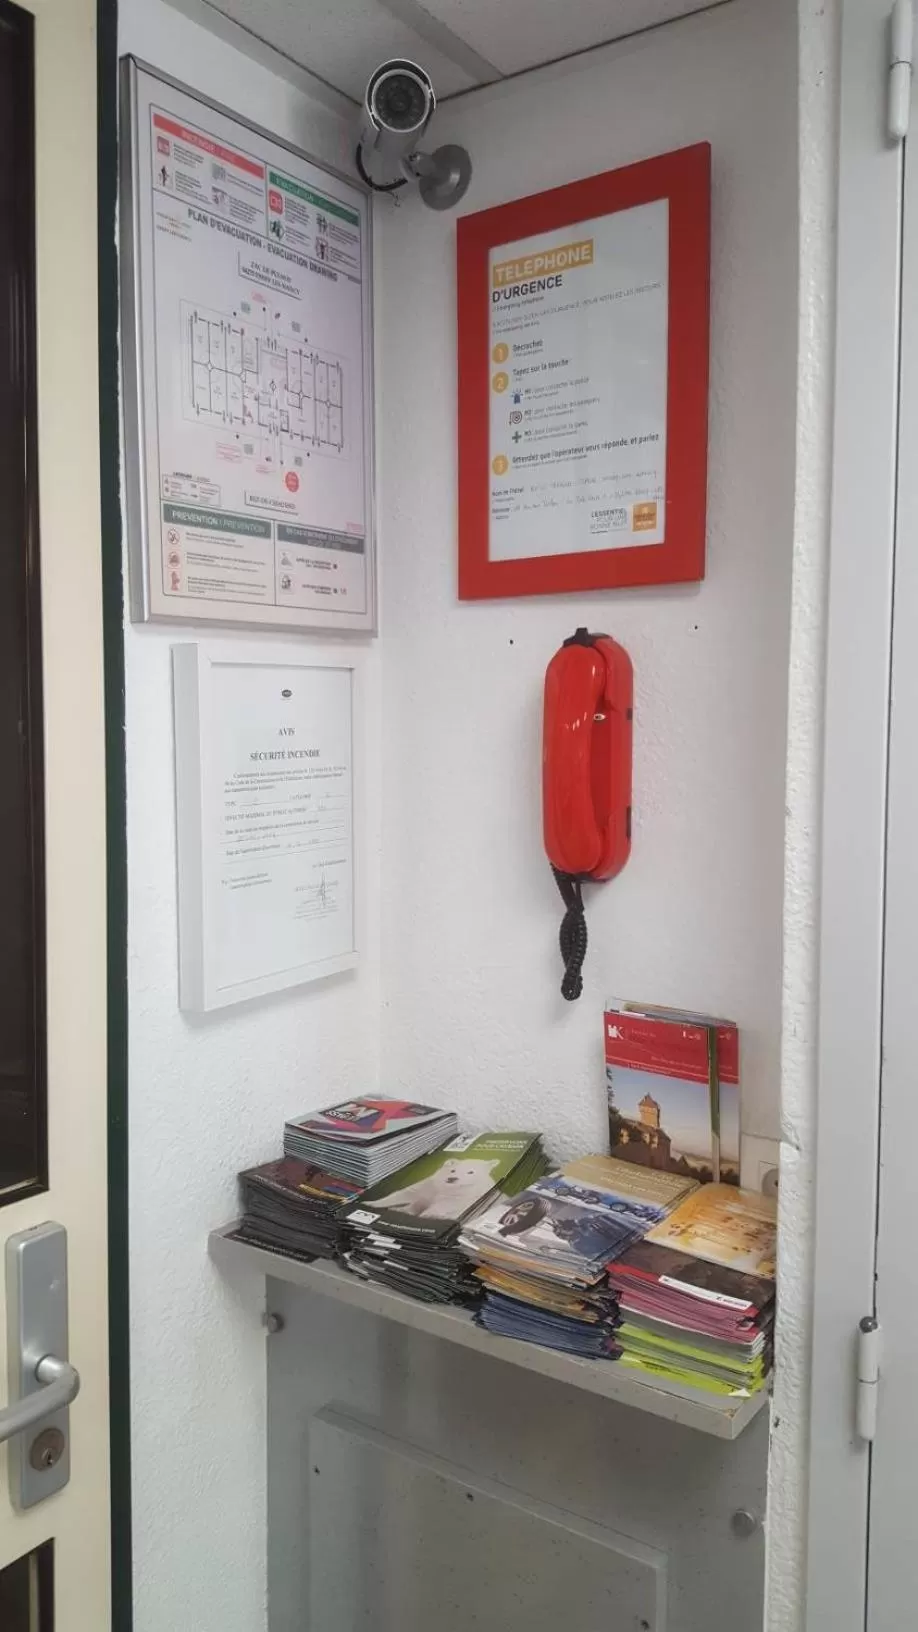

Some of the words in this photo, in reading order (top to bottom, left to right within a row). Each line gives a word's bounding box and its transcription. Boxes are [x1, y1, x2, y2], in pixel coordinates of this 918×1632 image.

[187, 207, 207, 225] PLAN
[210, 217, 261, 249] D'EVACUATION
[267, 242, 307, 268] EVACUATION
[309, 261, 337, 282] DRAWING
[495, 244, 591, 283] TELEPHONE
[492, 275, 563, 304] D'URGENCE
[497, 347, 503, 360] 1
[513, 366, 529, 377] Tapez
[497, 377, 503, 389] 2
[630, 436, 637, 444] et
[171, 510, 218, 525] PREVENTION
[221, 519, 265, 534] PREVENTION
[249, 749, 285, 761] SÉCURITÉ
[287, 749, 320, 758] INCENDIE
